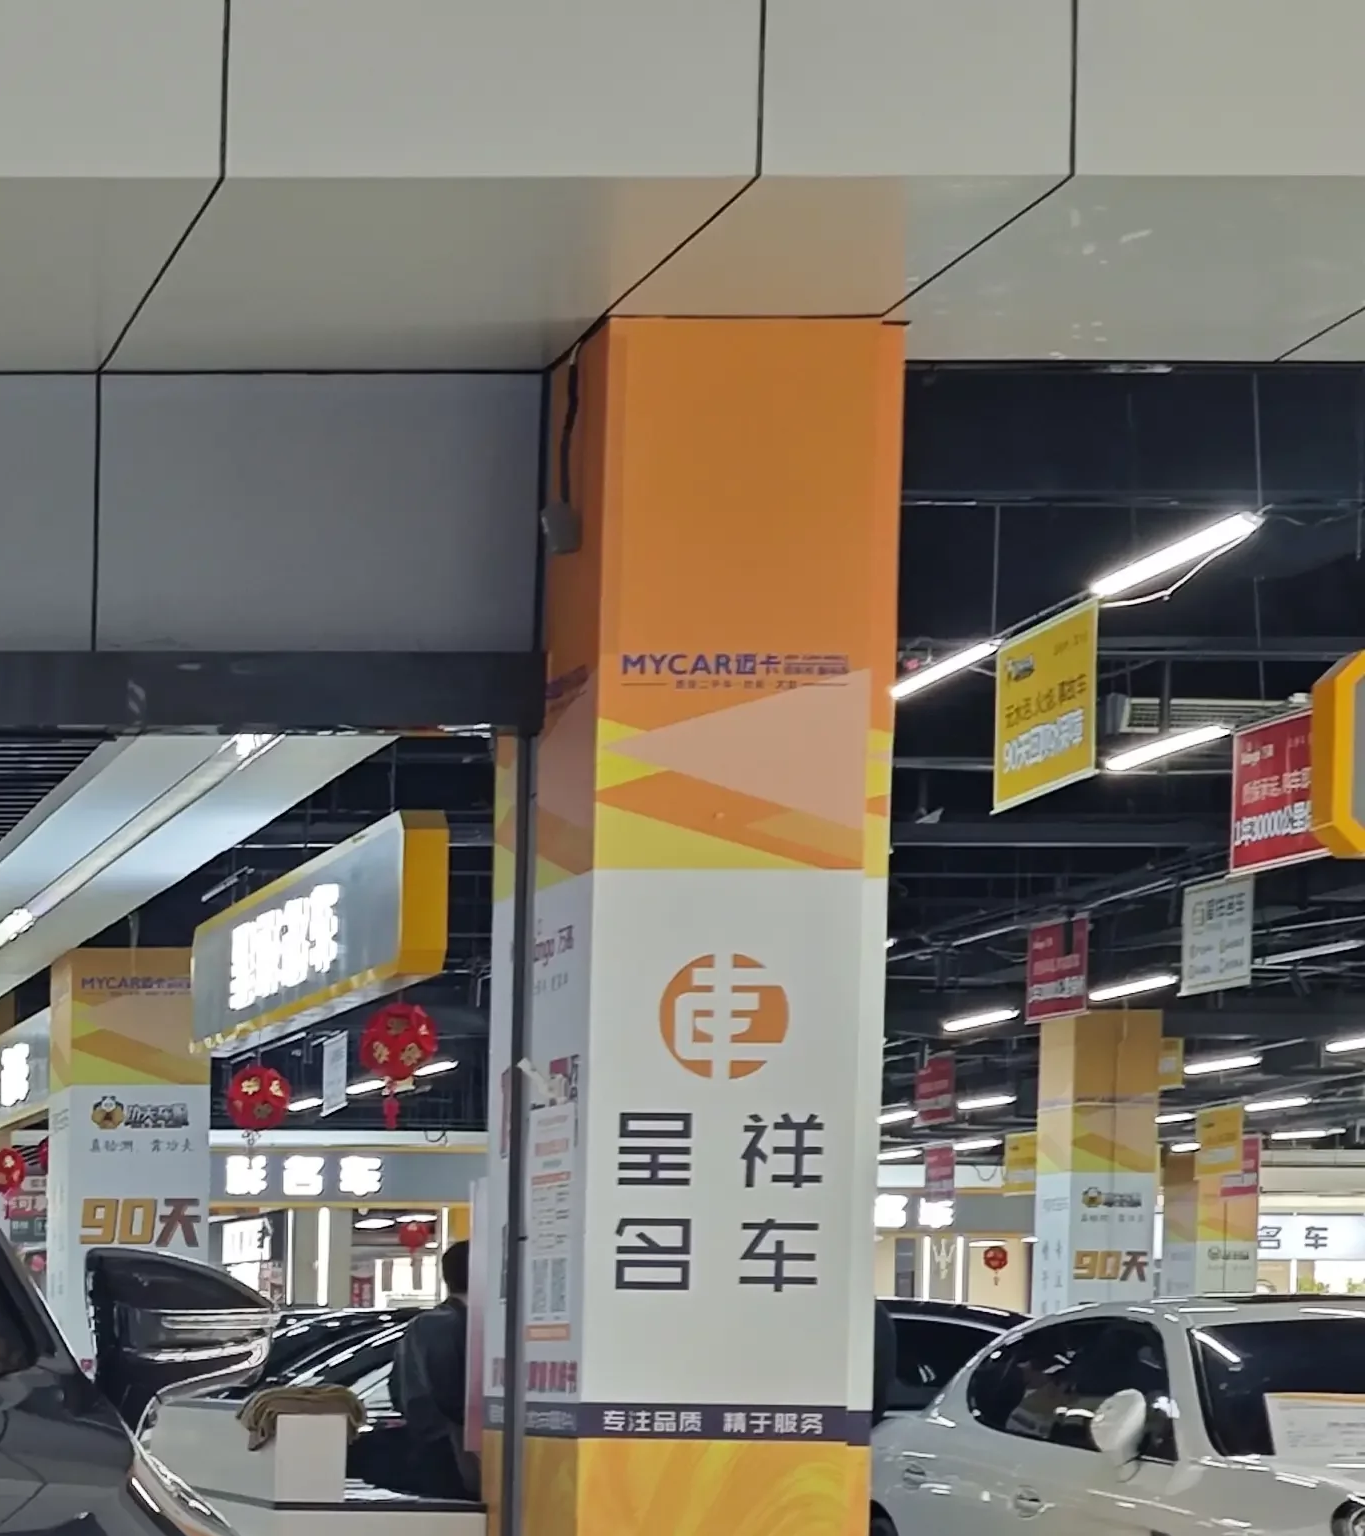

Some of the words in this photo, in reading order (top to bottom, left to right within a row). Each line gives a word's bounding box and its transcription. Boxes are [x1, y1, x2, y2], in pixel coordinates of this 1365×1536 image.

[617, 1111, 825, 1188] 呈祥
[80, 1198, 202, 1247] 90天
[1258, 1225, 1329, 1250] 名车
[615, 1218, 820, 1293] 名车
[1073, 1250, 1149, 1282] 90天
[602, 1409, 703, 1434] 专注品质
[722, 1410, 824, 1435] 精于服务
